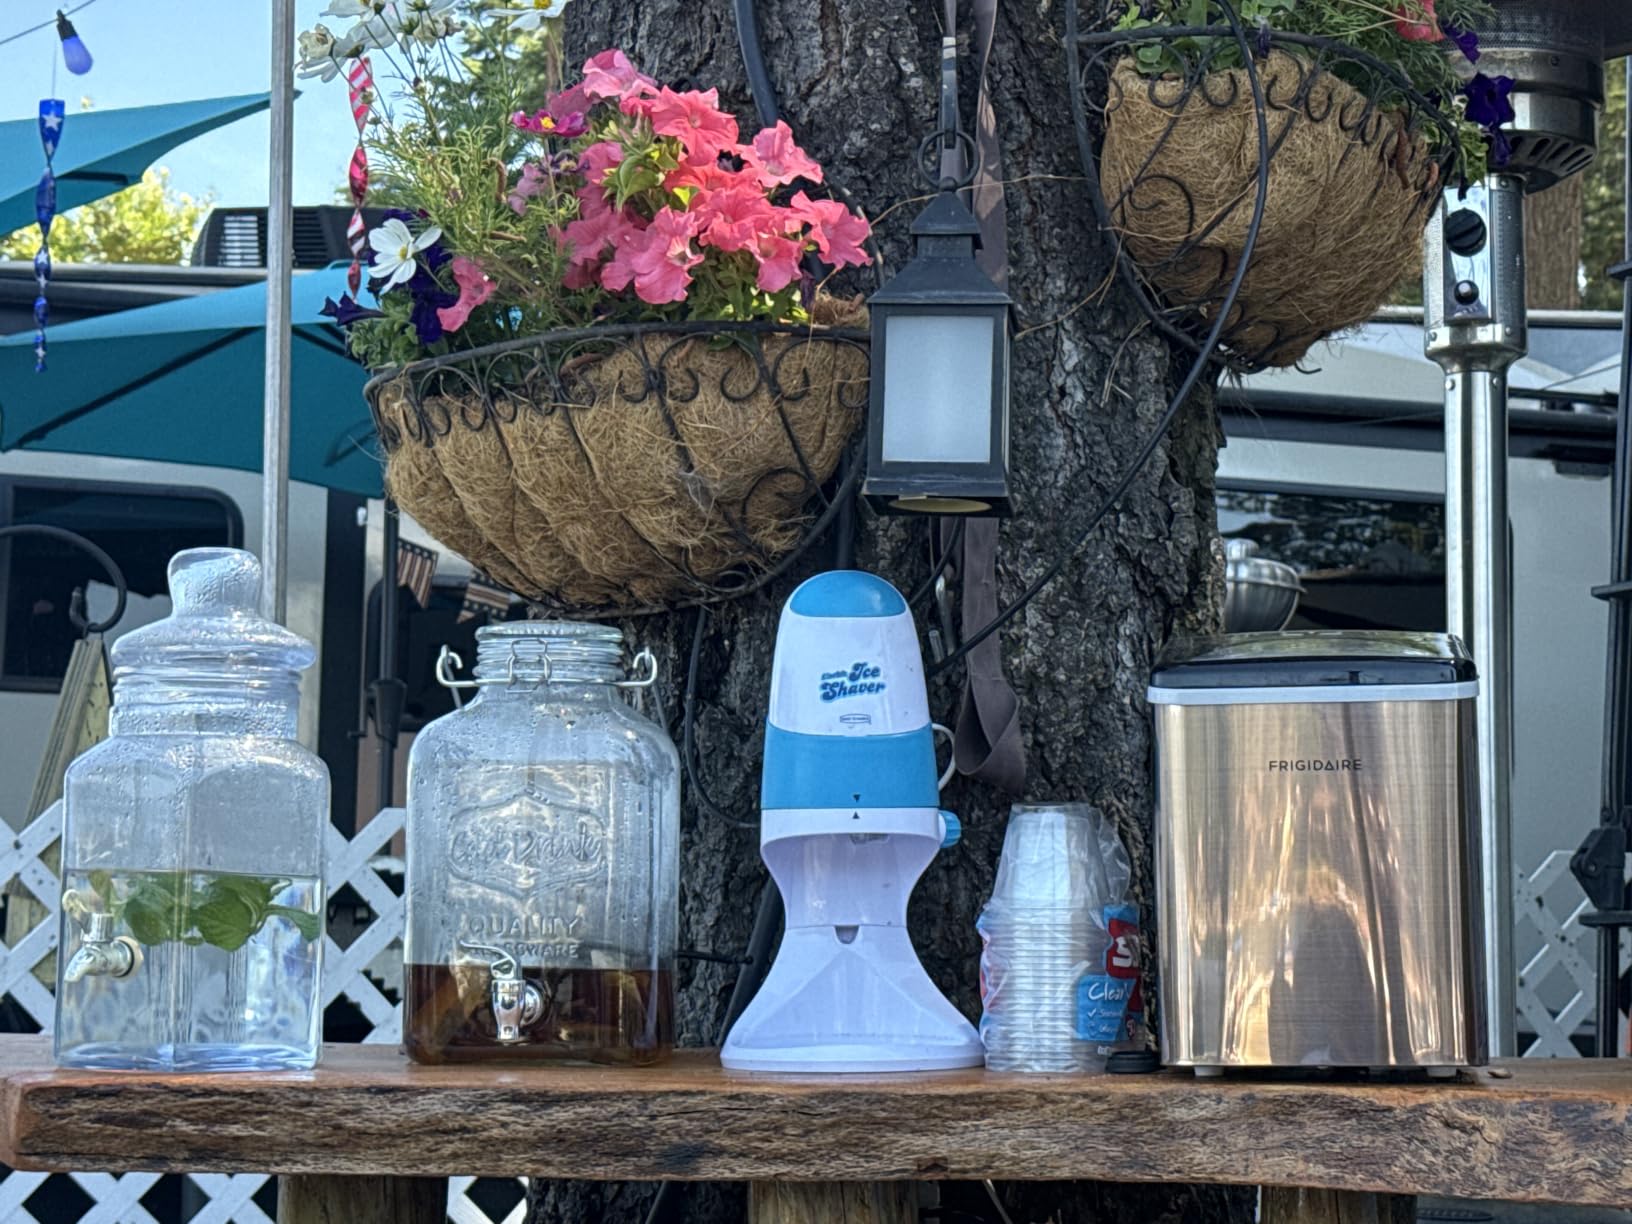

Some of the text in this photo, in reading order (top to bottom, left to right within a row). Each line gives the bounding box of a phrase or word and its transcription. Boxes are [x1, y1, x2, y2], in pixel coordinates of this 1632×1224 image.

[848, 661, 881, 682] Ice
[820, 681, 886, 701] Shaver
[1268, 759, 1362, 772] FRIGIDAIRE
[468, 914, 581, 937] QUALITY
